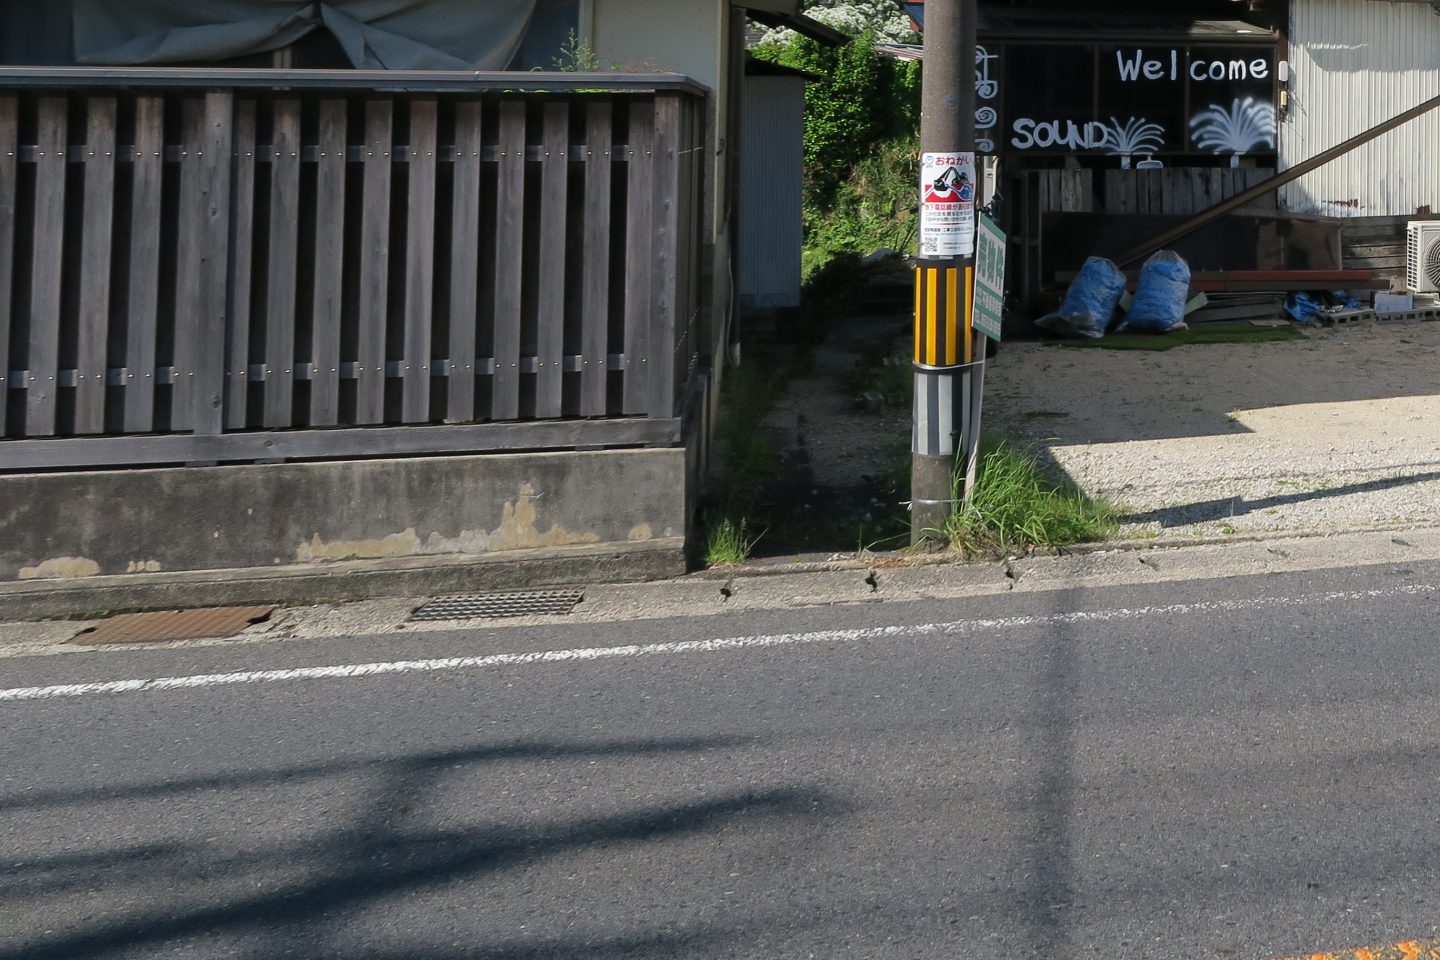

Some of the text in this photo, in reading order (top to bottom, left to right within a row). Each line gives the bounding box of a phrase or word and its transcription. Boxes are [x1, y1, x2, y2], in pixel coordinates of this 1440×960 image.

[1116, 49, 1269, 81] Welcome
[1011, 117, 1109, 150] SOUND
[935, 155, 972, 166] おねがい
[977, 231, 1004, 290] 売物件
